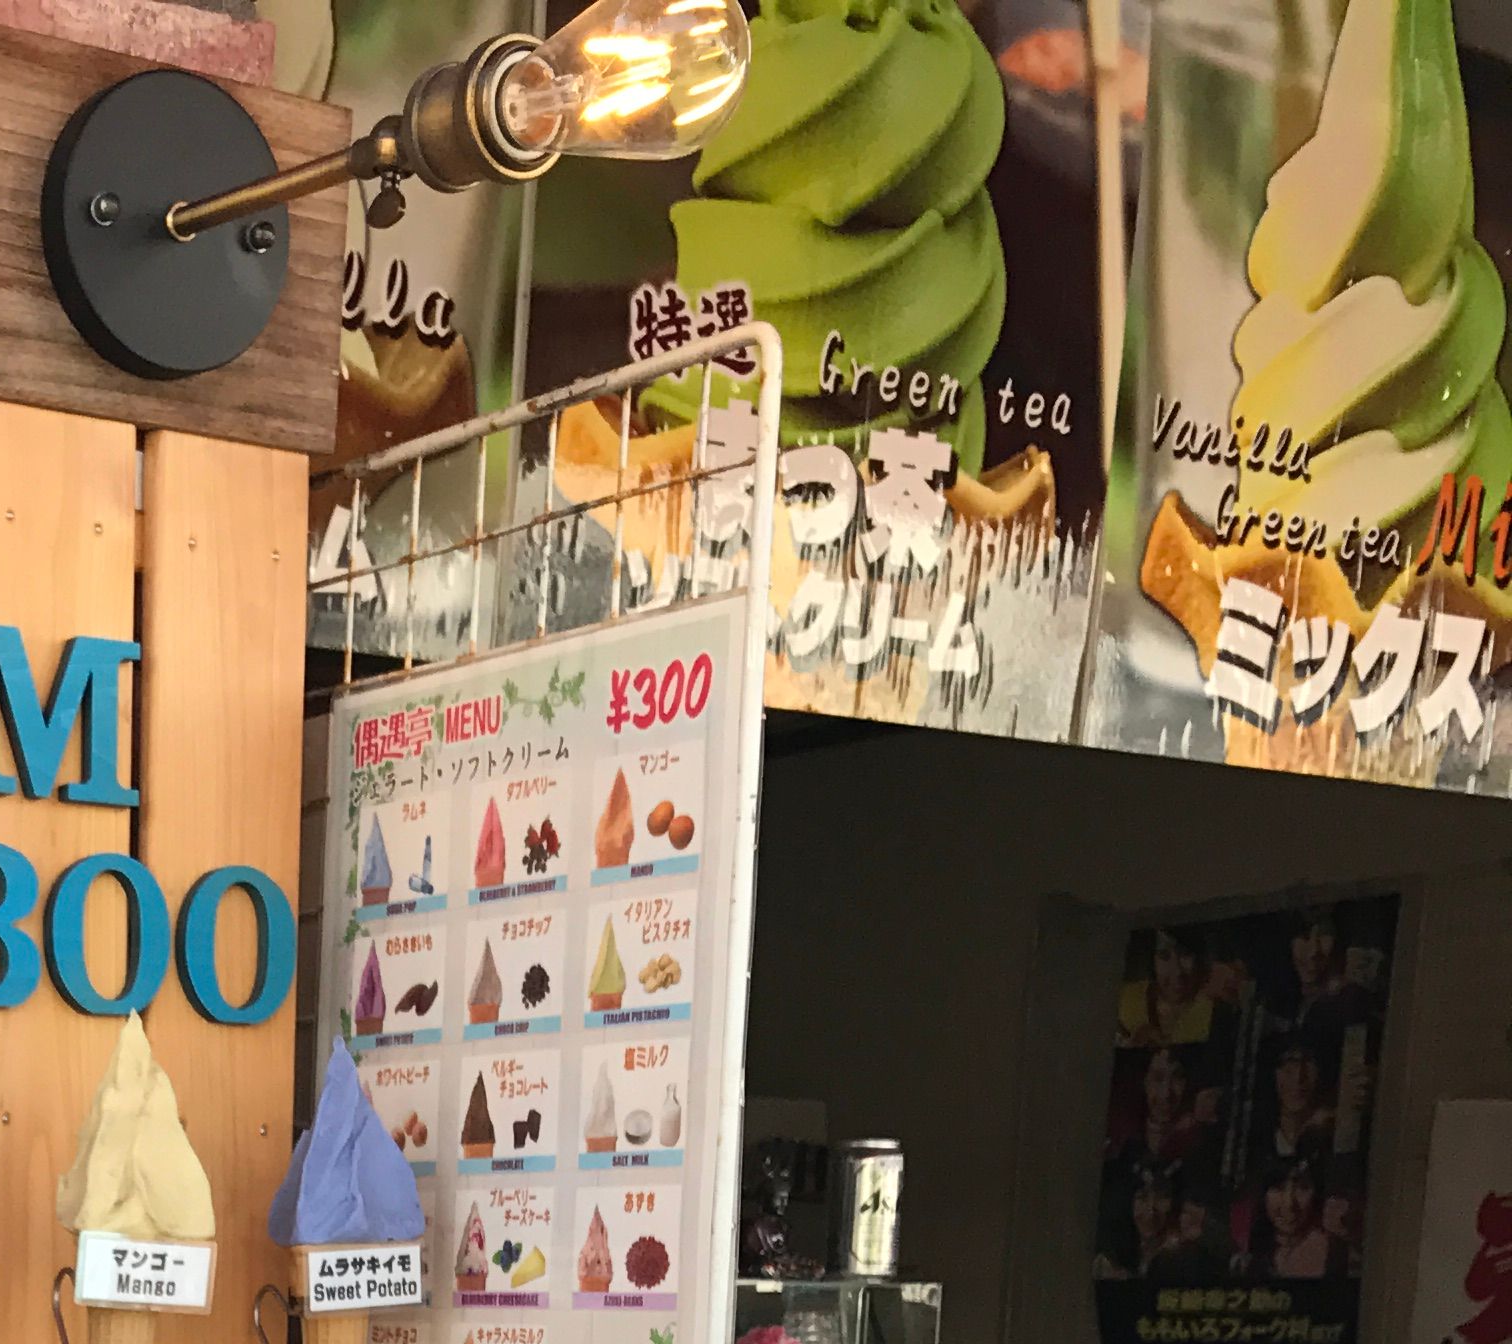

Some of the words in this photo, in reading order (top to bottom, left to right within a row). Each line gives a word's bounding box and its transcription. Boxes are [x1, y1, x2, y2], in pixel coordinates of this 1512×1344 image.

[819, 329, 964, 416] Green
[998, 377, 1072, 435] tea
[1152, 393, 1311, 482] Vanilla
[1215, 485, 1327, 558] Green
[1342, 516, 1401, 567] tea
[1204, 577, 1486, 742] ミックス
[607, 652, 713, 734] ¥300
[354, 706, 435, 769] 偶遇亭
[445, 695, 502, 744] MENU
[639, 750, 680, 775] マンゴー
[623, 898, 674, 924] イタリアン
[110, 1246, 186, 1271] マンゴー
[317, 1252, 414, 1279] ムラサキイモ
[116, 1273, 176, 1299] Mango
[313, 1279, 362, 1303] Sweet
[366, 1275, 419, 1299] Potato
